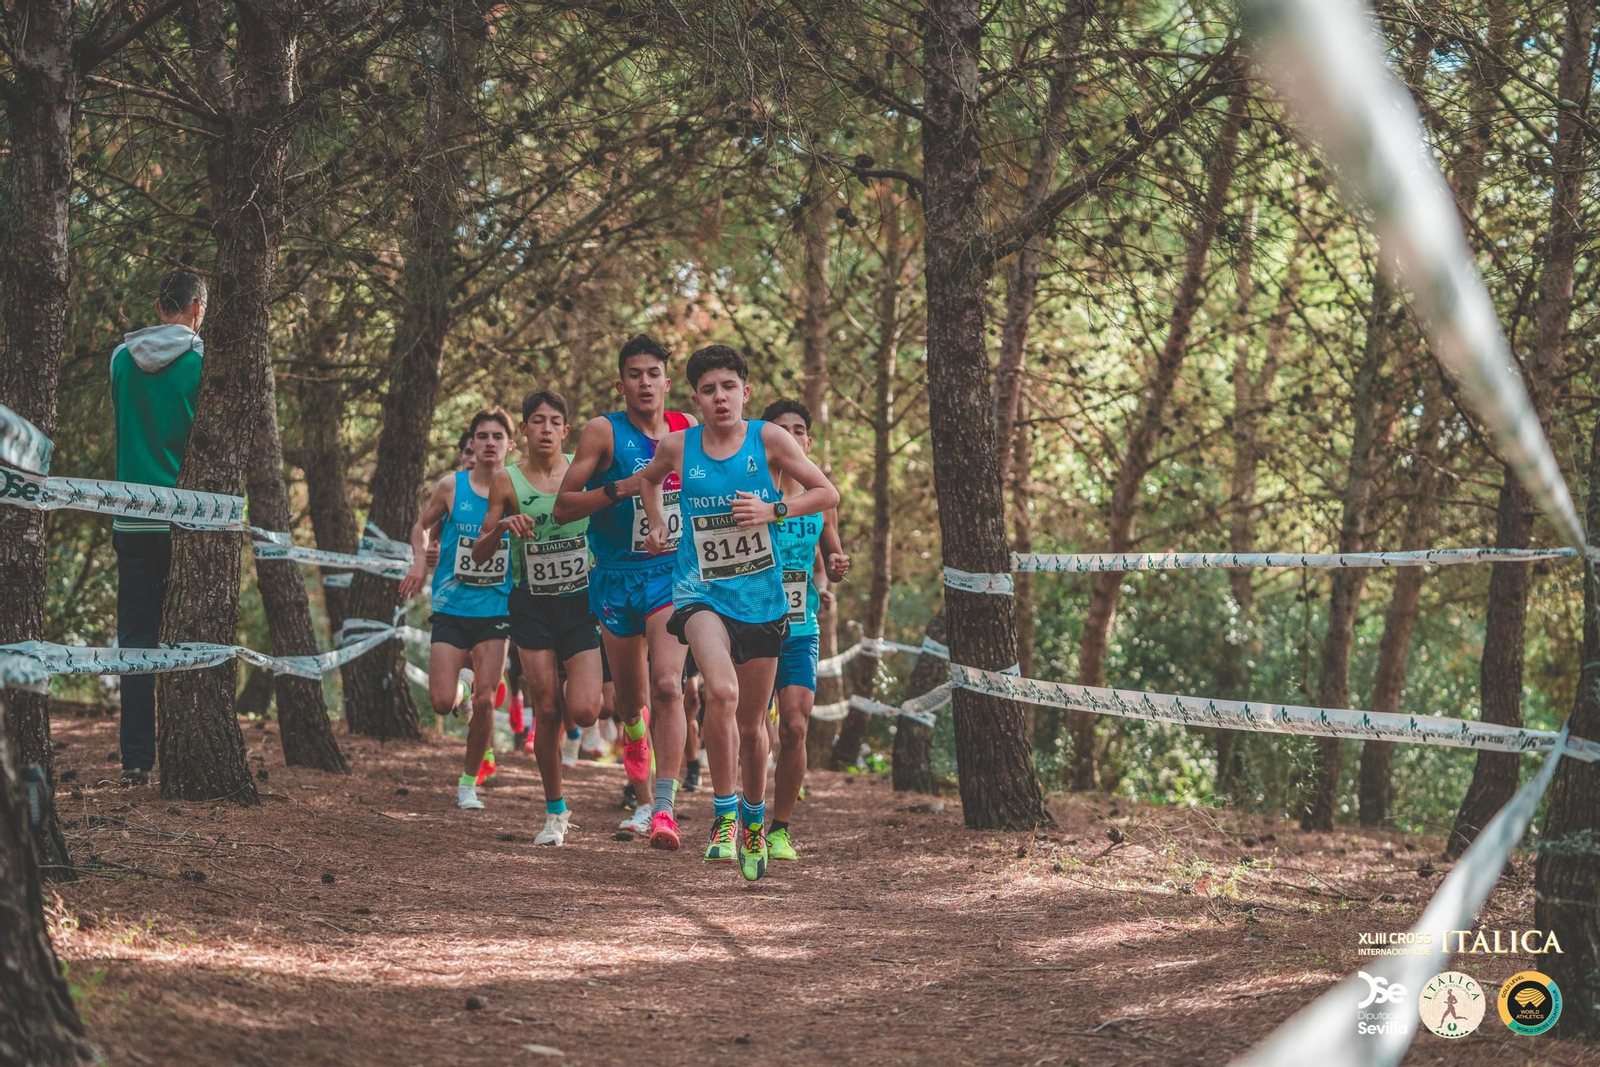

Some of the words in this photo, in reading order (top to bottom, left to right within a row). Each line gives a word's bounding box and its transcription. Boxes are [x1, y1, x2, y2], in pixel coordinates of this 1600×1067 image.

[688, 487, 769, 509] TROTASRA
[777, 516, 817, 538] erja
[702, 531, 767, 562] 8141
[533, 557, 585, 581] 8152
